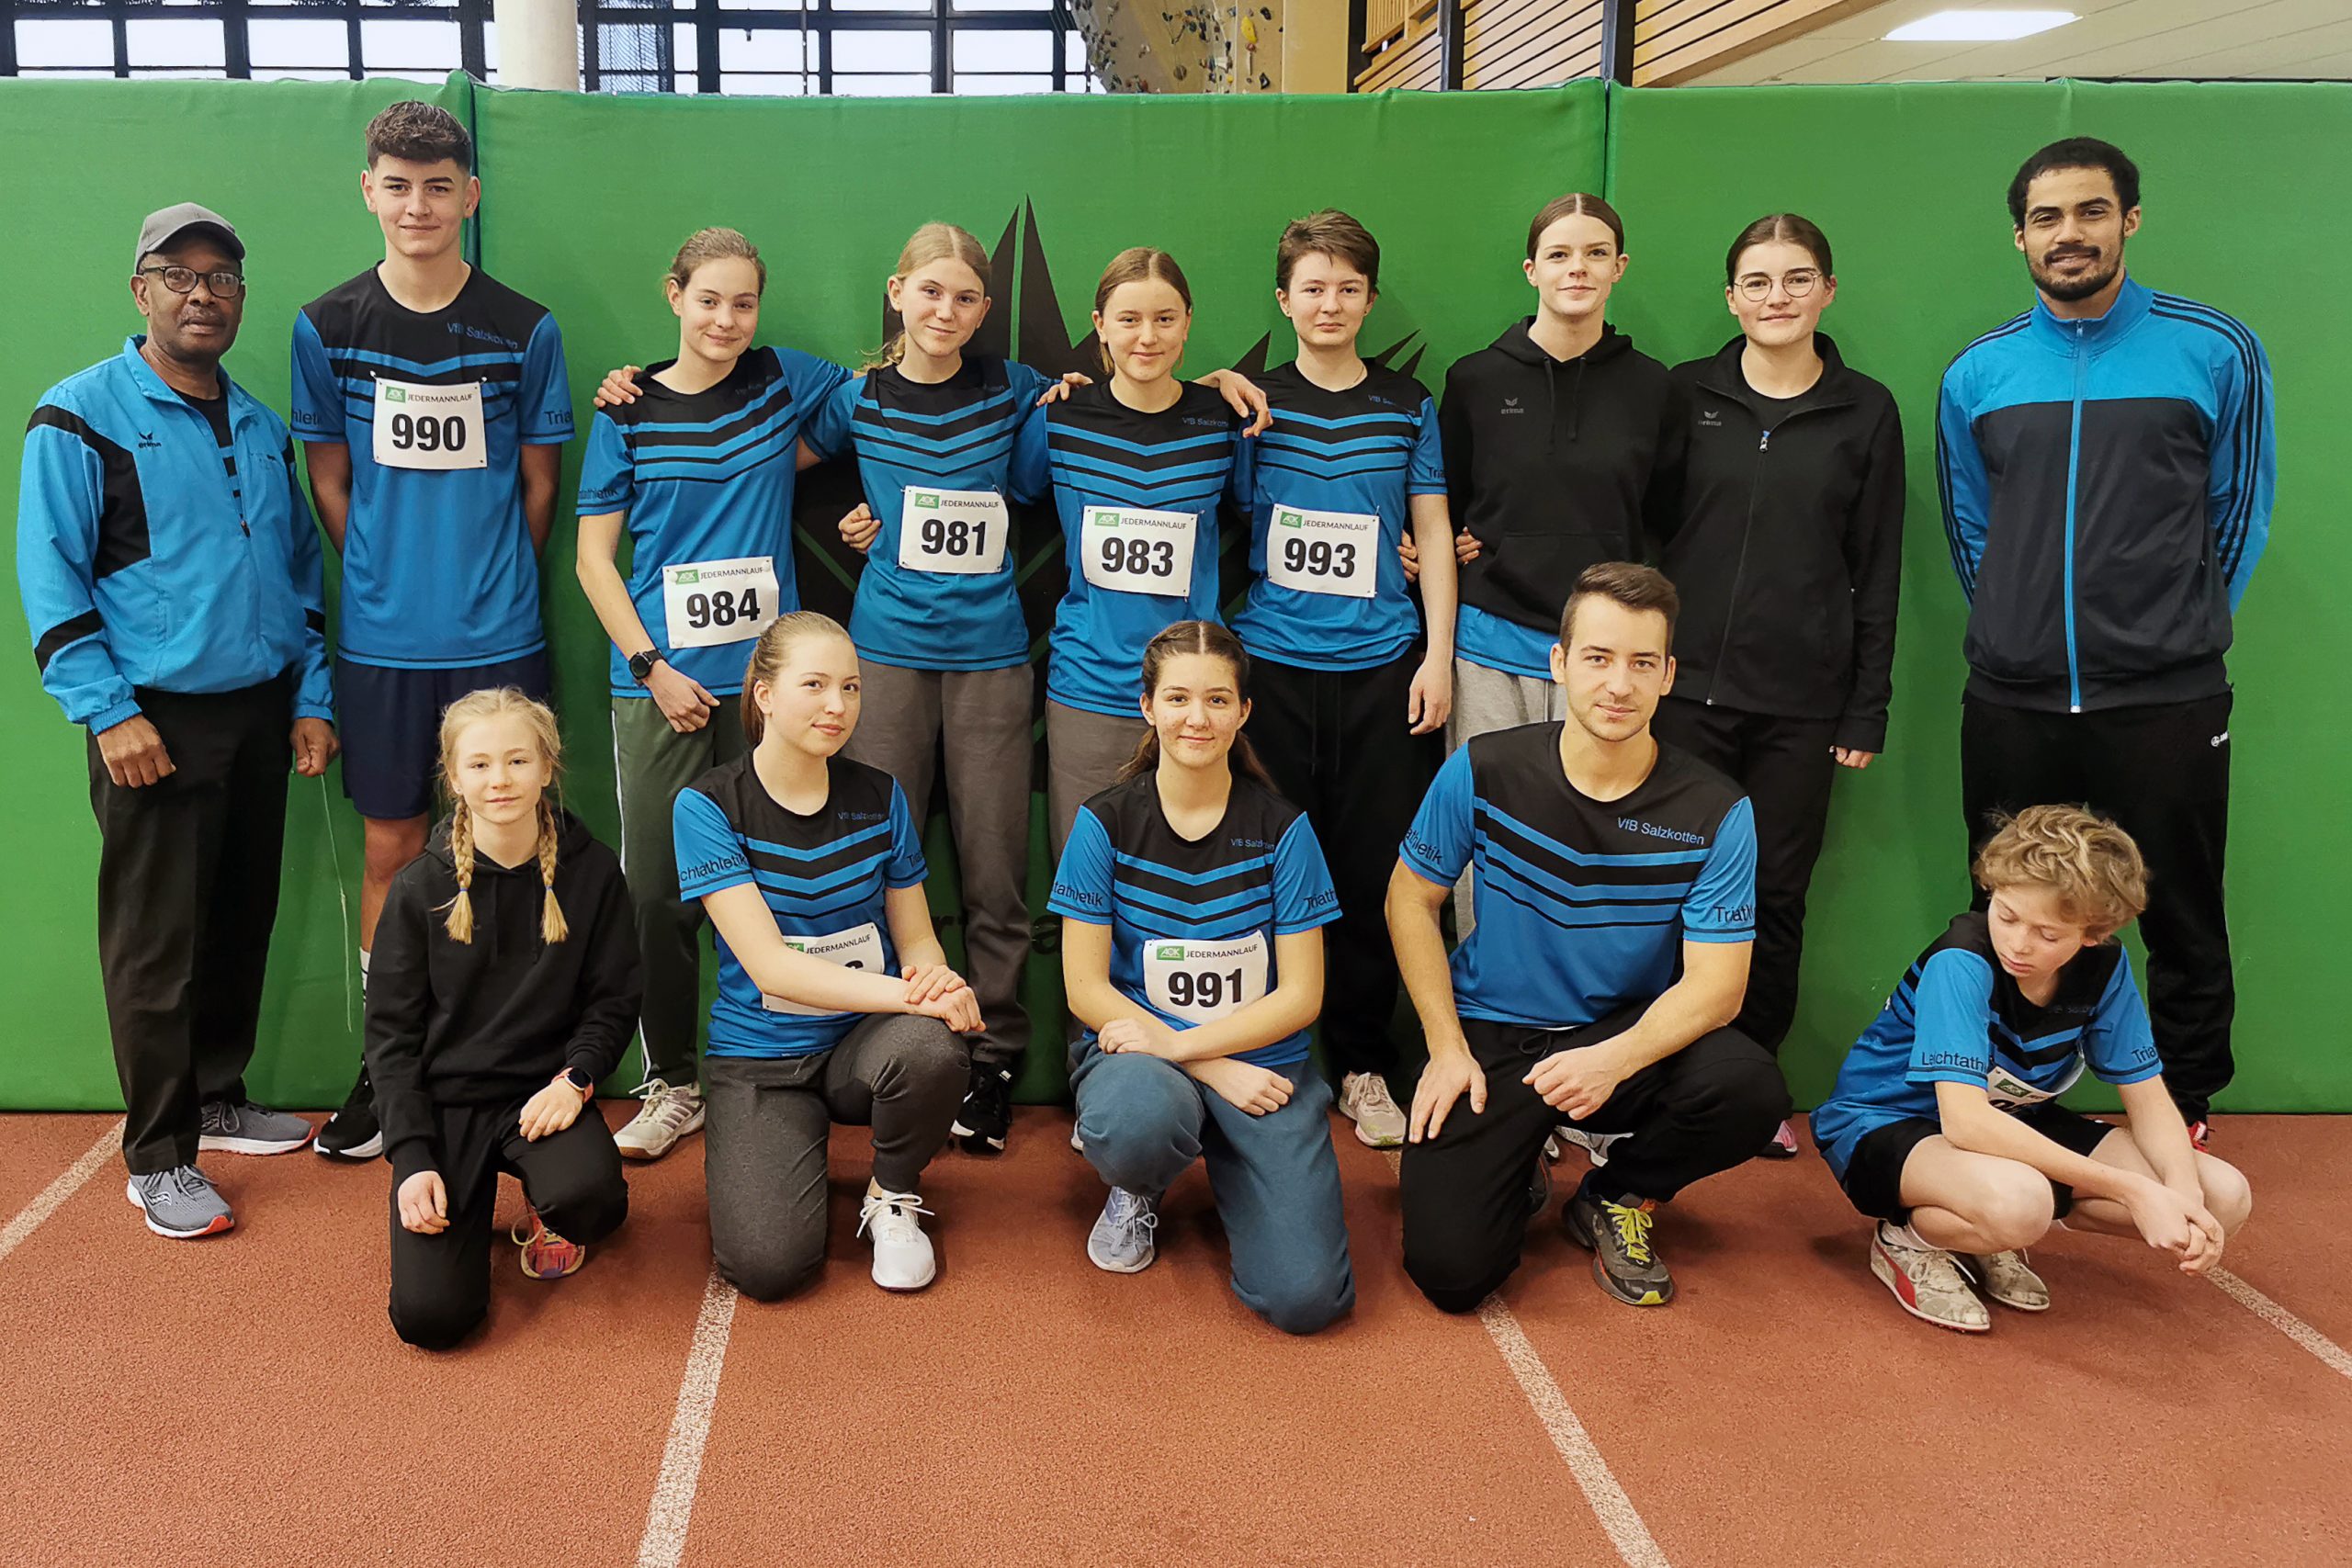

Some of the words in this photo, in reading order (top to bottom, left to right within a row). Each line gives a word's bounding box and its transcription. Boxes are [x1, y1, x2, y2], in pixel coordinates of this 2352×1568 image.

[407, 393, 472, 403] JEDERMANNLAUF
[391, 413, 467, 452] 990
[940, 500, 1000, 509] JEDERMANNLAUF
[1120, 517, 1188, 530] JEDERMANNLAUF
[1302, 520, 1370, 531] JEDERMANNLAUF
[921, 519, 987, 557] 981
[1102, 537, 1174, 578] 983
[1283, 538, 1356, 579] 993
[699, 567, 763, 581] JEDERMANNLAUF
[686, 588, 761, 629] 984
[1617, 817, 1639, 832] VfB
[1640, 822, 1705, 846] Salzkotten
[806, 933, 871, 954] JEDERMANNLAUF
[1185, 943, 1258, 959] JEDERMANNLAUF
[1167, 967, 1242, 1009] 991
[2131, 1045, 2157, 1064] Tria
